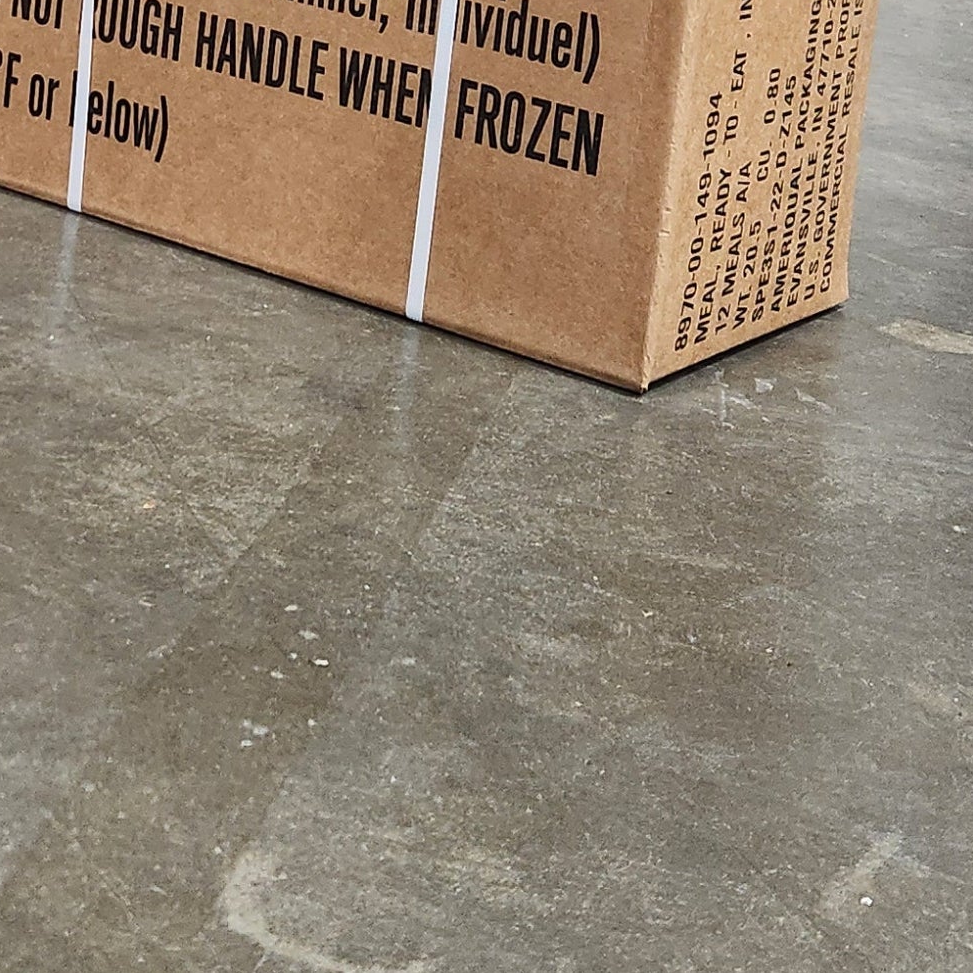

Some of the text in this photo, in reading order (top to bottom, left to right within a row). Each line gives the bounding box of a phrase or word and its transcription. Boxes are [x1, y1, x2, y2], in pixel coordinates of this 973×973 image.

[28, 71, 61, 121] or
[194, 10, 329, 101] HANDLE
[454, 77, 604, 177] FROZEN
[710, 168, 733, 252] READY
[723, 115, 739, 145] TO
[731, 49, 747, 92] EAT
[732, 68, 781, 330] WT. 20.5 CU. 0.80
[752, 75, 797, 322] SPE3S1-22-D-Z145
[771, 0, 822, 312] AMERIQUAL PACKAGING
[803, 252, 820, 301] U.S.
[813, 70, 841, 242] GOVERNMENT
[812, 106, 823, 132] IN
[820, 124, 848, 293] COMMERCIAL
[842, 24, 860, 116] RESALE
[675, 91, 722, 351] 8970-00-149-1094
[715, 161, 751, 335] 12 MEALS A/A
